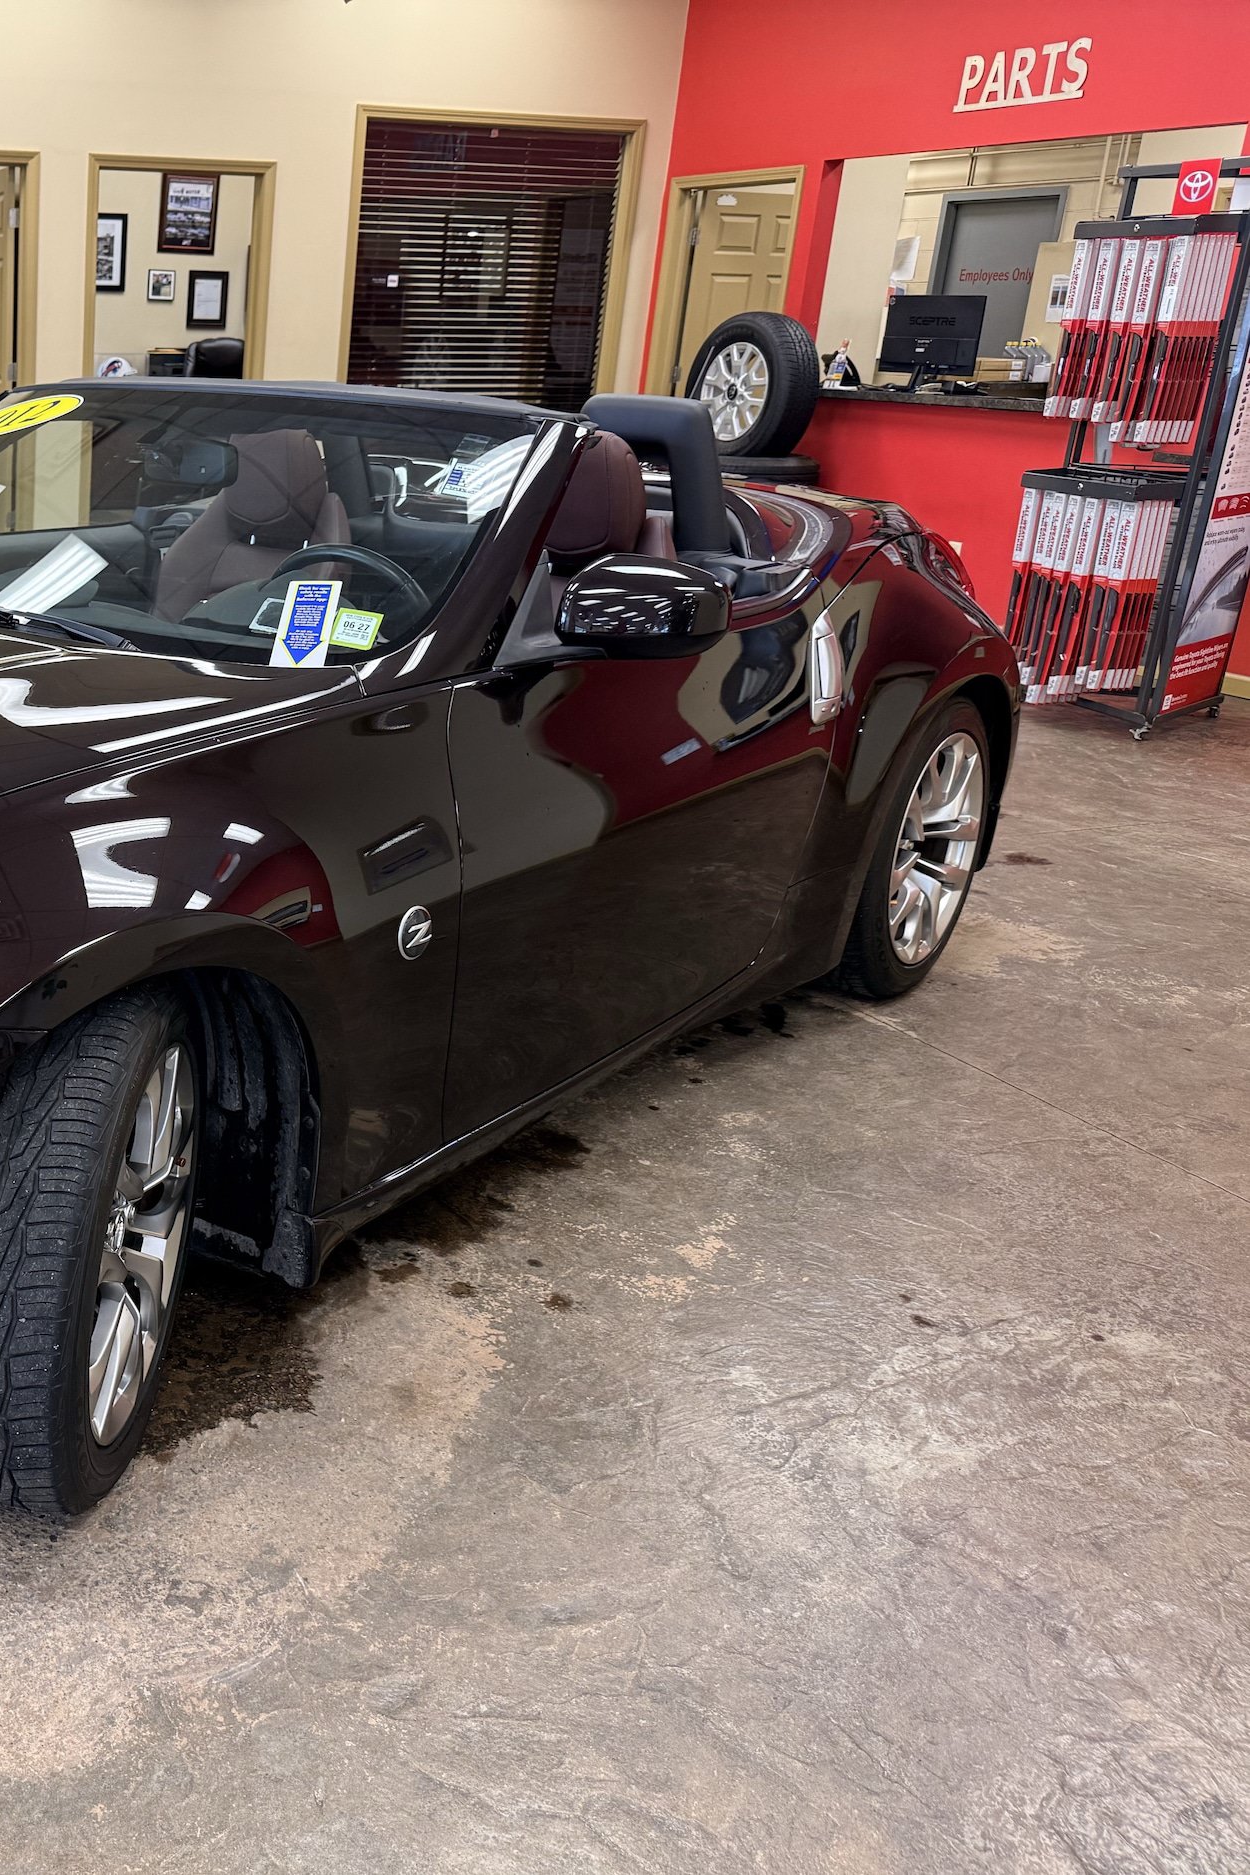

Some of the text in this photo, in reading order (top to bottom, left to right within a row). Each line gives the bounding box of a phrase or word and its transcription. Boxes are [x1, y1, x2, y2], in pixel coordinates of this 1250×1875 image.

[953, 37, 1093, 113] PARTS
[959, 267, 1034, 285] Employees Only
[1094, 258, 1108, 310] ALL-WEATHER
[1118, 258, 1133, 312] ALL-WEATHER
[1140, 258, 1155, 313] ALL-WEATHER
[910, 316, 956, 326] SCEPTRE
[1018, 505, 1030, 552] ALL-WEATHER
[1060, 512, 1074, 561] ALL-WEATHER
[1078, 516, 1092, 565] ALL-WEATHER
[1102, 516, 1116, 566] ALL-WEATHER
[1116, 519, 1132, 570] ALL-WEATHER
[343, 620, 370, 631] 06 27
